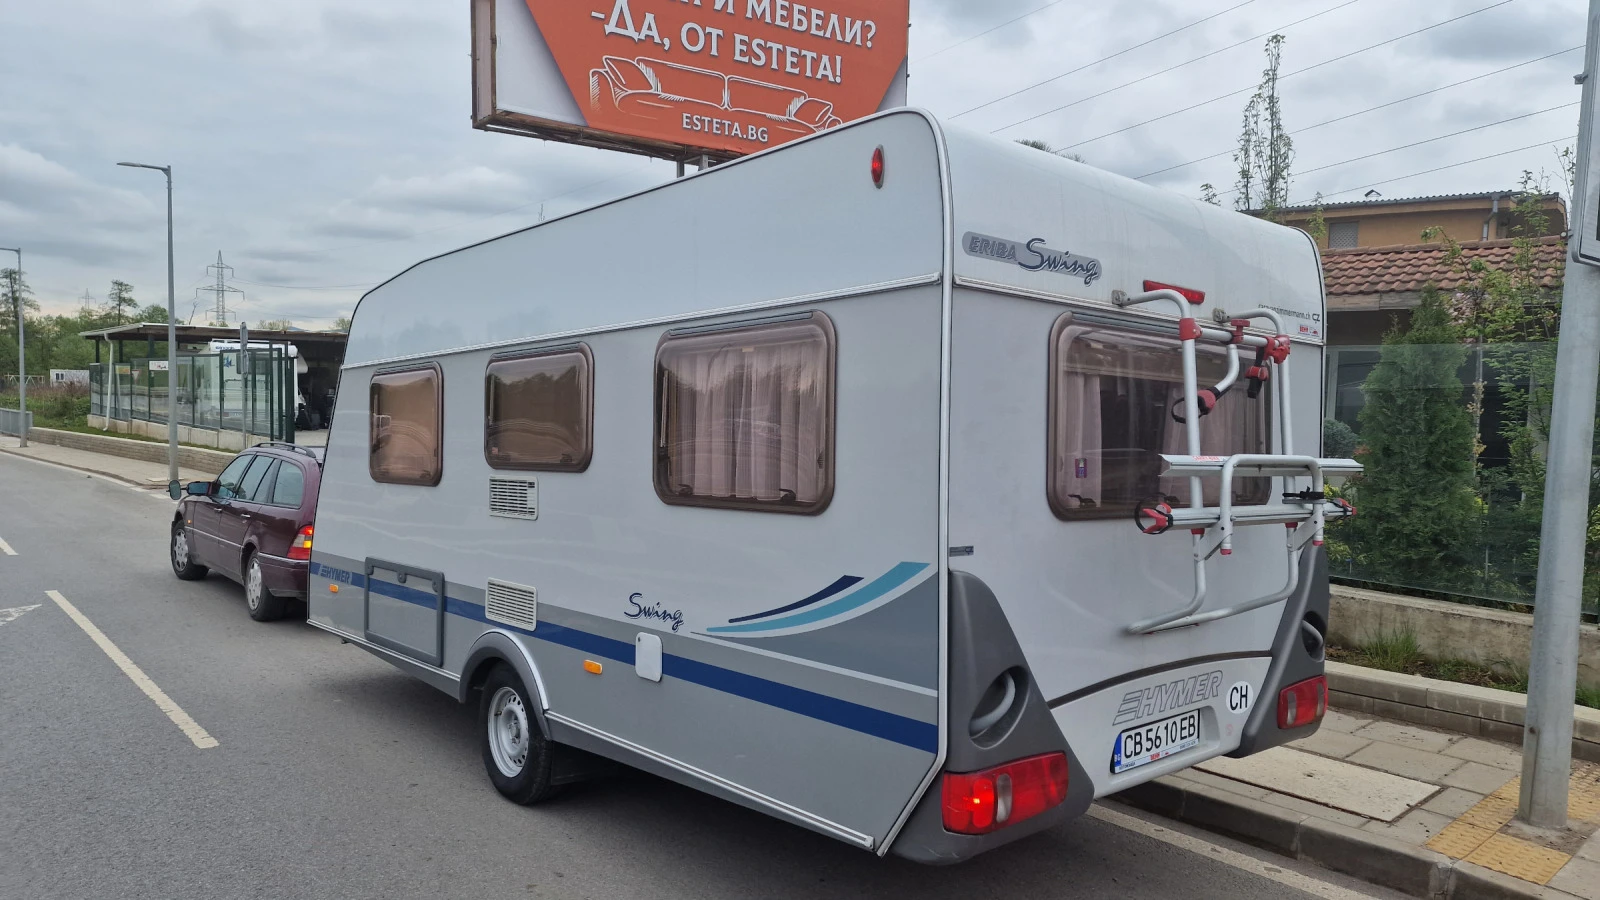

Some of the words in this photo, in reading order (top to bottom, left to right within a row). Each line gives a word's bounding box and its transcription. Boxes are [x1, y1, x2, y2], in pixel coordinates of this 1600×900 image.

[745, 0, 877, 48] МЕБЕЛИ?
[680, 22, 723, 56] ОТ
[733, 33, 842, 84] ESTETA!
[682, 112, 768, 142] ESTETA.BG
[968, 235, 1017, 261] ERIBA
[1018, 238, 1098, 286] Swing
[325, 566, 351, 585] HYMER
[624, 592, 684, 633] Swing
[1136, 670, 1223, 719] HYMER
[1229, 685, 1248, 710] CH
[1124, 733, 1142, 759] CB
[1181, 714, 1196, 741] EB
